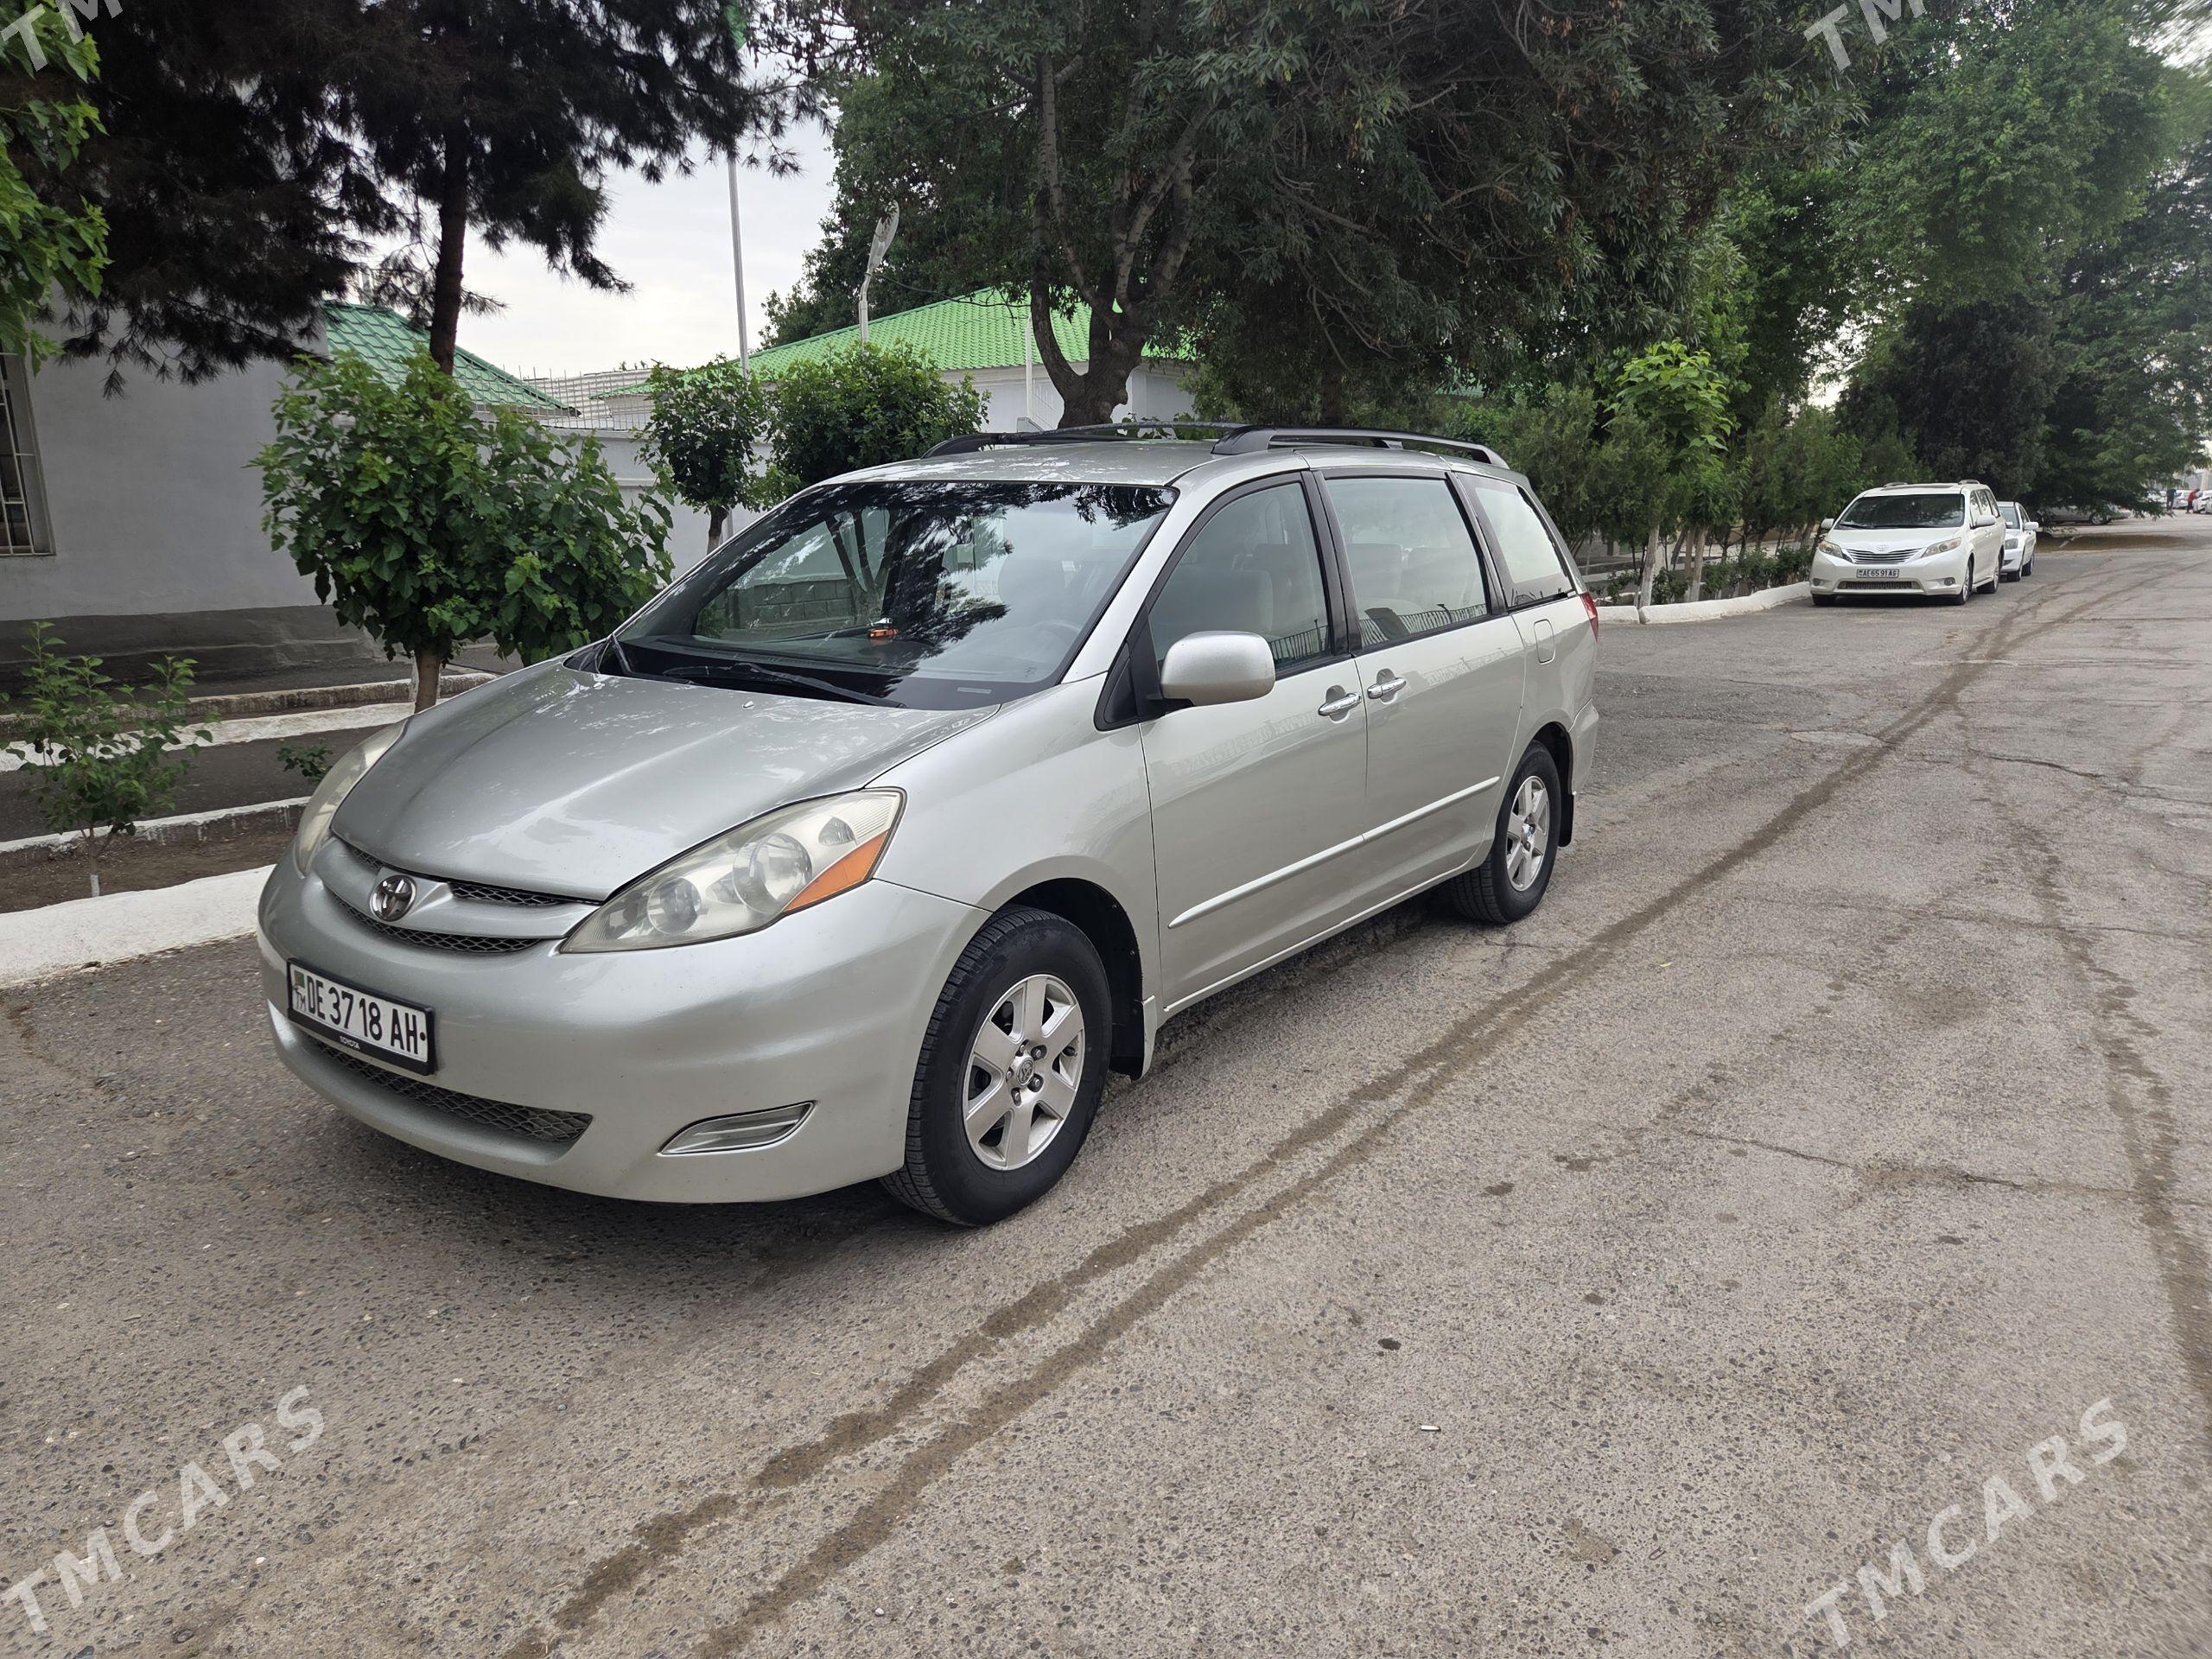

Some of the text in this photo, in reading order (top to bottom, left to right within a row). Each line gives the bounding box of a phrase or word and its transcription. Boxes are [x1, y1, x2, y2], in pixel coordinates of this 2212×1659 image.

[307, 975, 326, 1020] DE
[390, 1007, 418, 1055] AH
[339, 1035, 360, 1050] TOYOTA
